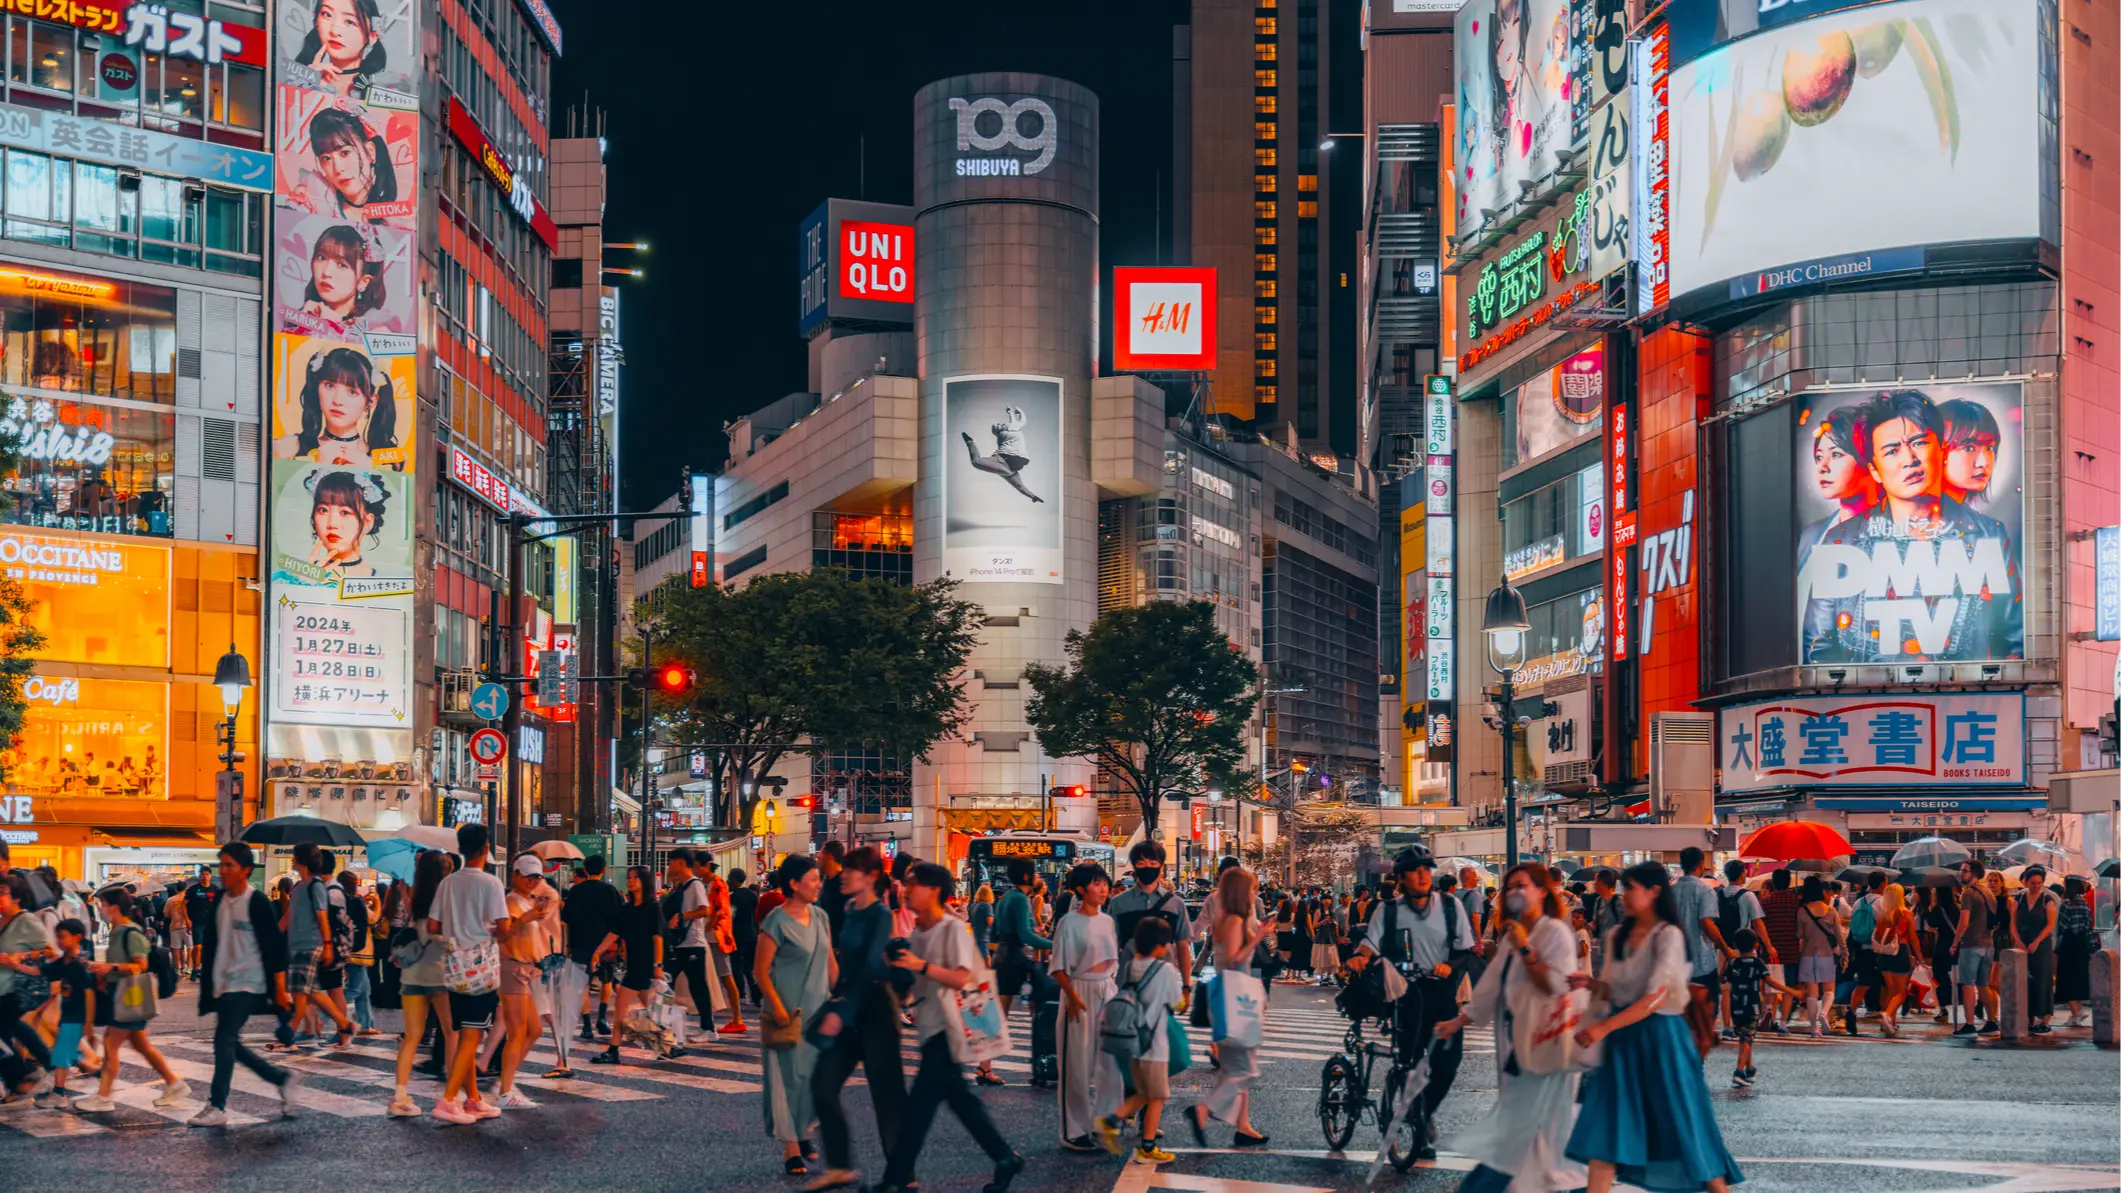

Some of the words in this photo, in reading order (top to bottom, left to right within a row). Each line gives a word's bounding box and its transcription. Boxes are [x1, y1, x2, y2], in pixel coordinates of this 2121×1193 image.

[1408, 2, 1460, 10] mastercard
[126, 4, 242, 63] ガスト
[104, 67, 133, 81] ガスト
[286, 62, 316, 82] JULIA
[52, 118, 266, 180] 英会話イーオン
[948, 97, 1058, 176] 109
[956, 159, 1020, 176] SHIBUYA
[371, 203, 409, 217] HITOKA
[849, 231, 901, 261] UNI
[849, 262, 906, 294] QLO
[1501, 251, 1544, 319] 西村
[1768, 265, 1803, 290] DHC
[1805, 256, 1872, 279] Channel
[284, 308, 325, 332] HARUKA
[600, 296, 614, 328] BIC
[1141, 301, 1192, 335] H&M
[600, 334, 615, 415] CAMERA
[0, 537, 122, 572] OCCITANE
[284, 558, 321, 579] HIYORI
[1811, 538, 2011, 599] DMM
[29, 569, 97, 585] PROVENCE
[970, 568, 993, 576] iPhone
[296, 615, 352, 632] 2024年
[1864, 598, 1958, 655] TV
[296, 637, 383, 657] 1月27日(土)
[296, 660, 383, 679] 1月28日(日)
[23, 676, 79, 705] Café
[294, 685, 390, 704] 横浜アリーナ
[1730, 710, 1998, 772] 大盛堂書店
[1943, 769, 1971, 778] BOOKS
[1973, 768, 2011, 778] TAISEIDO
